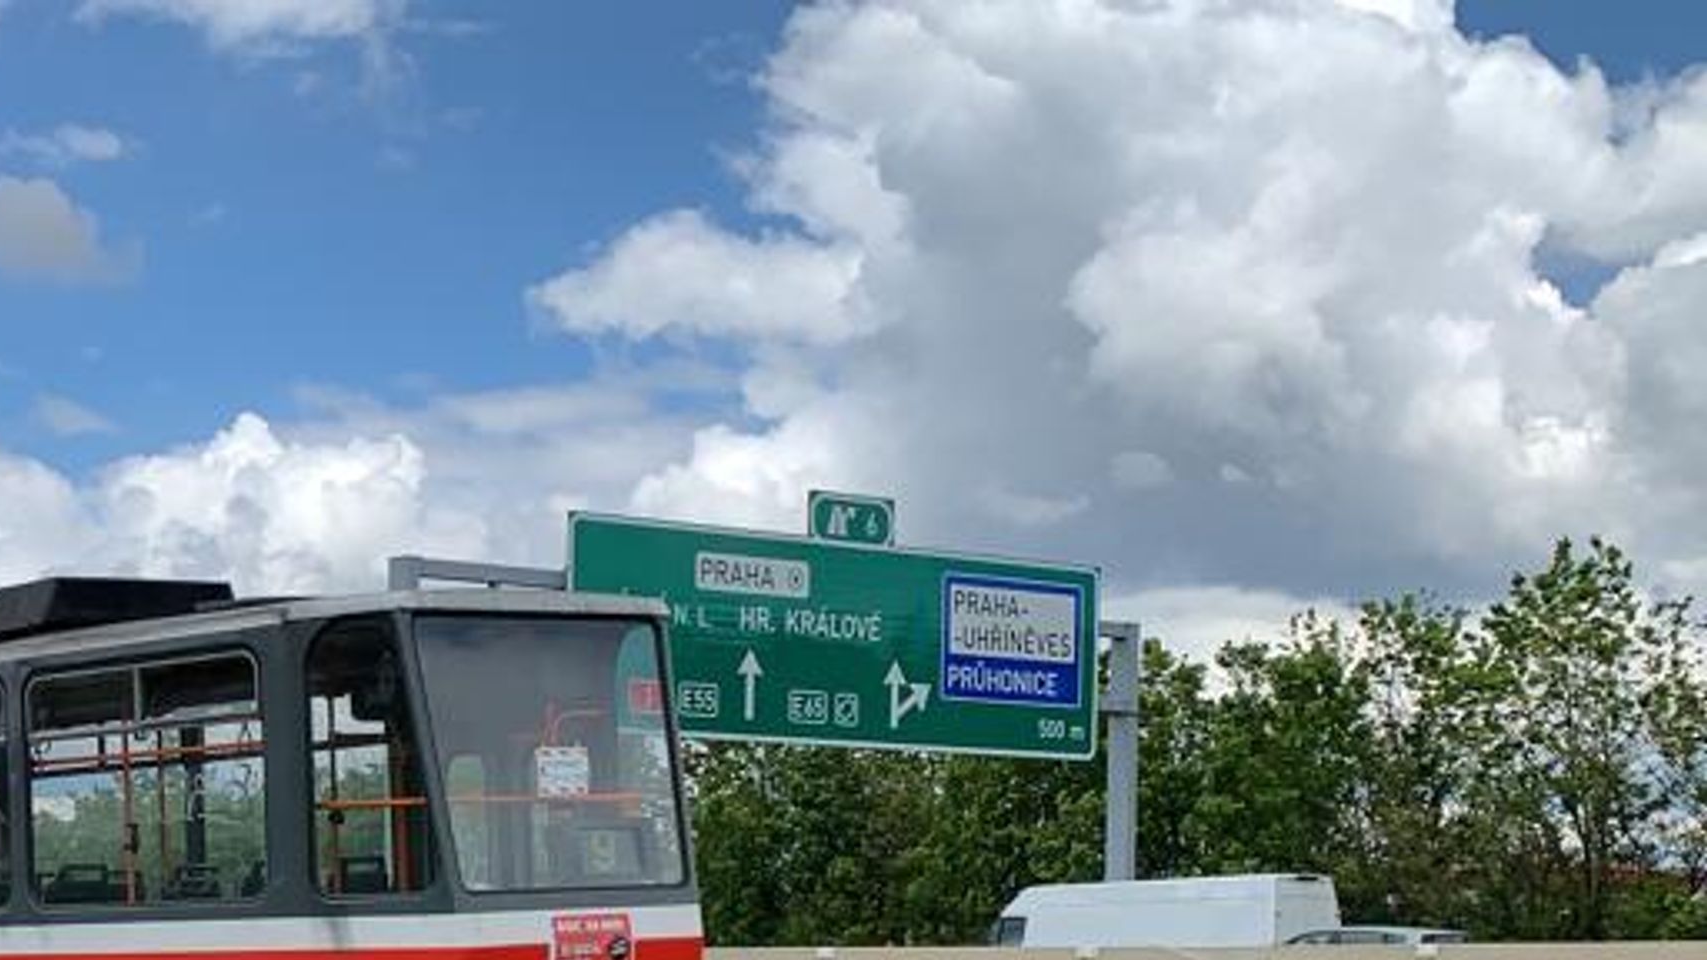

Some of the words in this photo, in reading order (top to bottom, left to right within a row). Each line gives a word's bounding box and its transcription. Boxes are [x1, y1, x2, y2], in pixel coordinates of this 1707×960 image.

[699, 557, 776, 590] PRAHA
[954, 590, 1029, 617] PRAHA-
[739, 606, 776, 633] HR.
[784, 606, 883, 642] KRÁLOVÉ
[946, 660, 1059, 697] PRŮHONICE
[682, 688, 714, 712] E55
[792, 695, 824, 719] E65
[1037, 718, 1066, 739] 500
